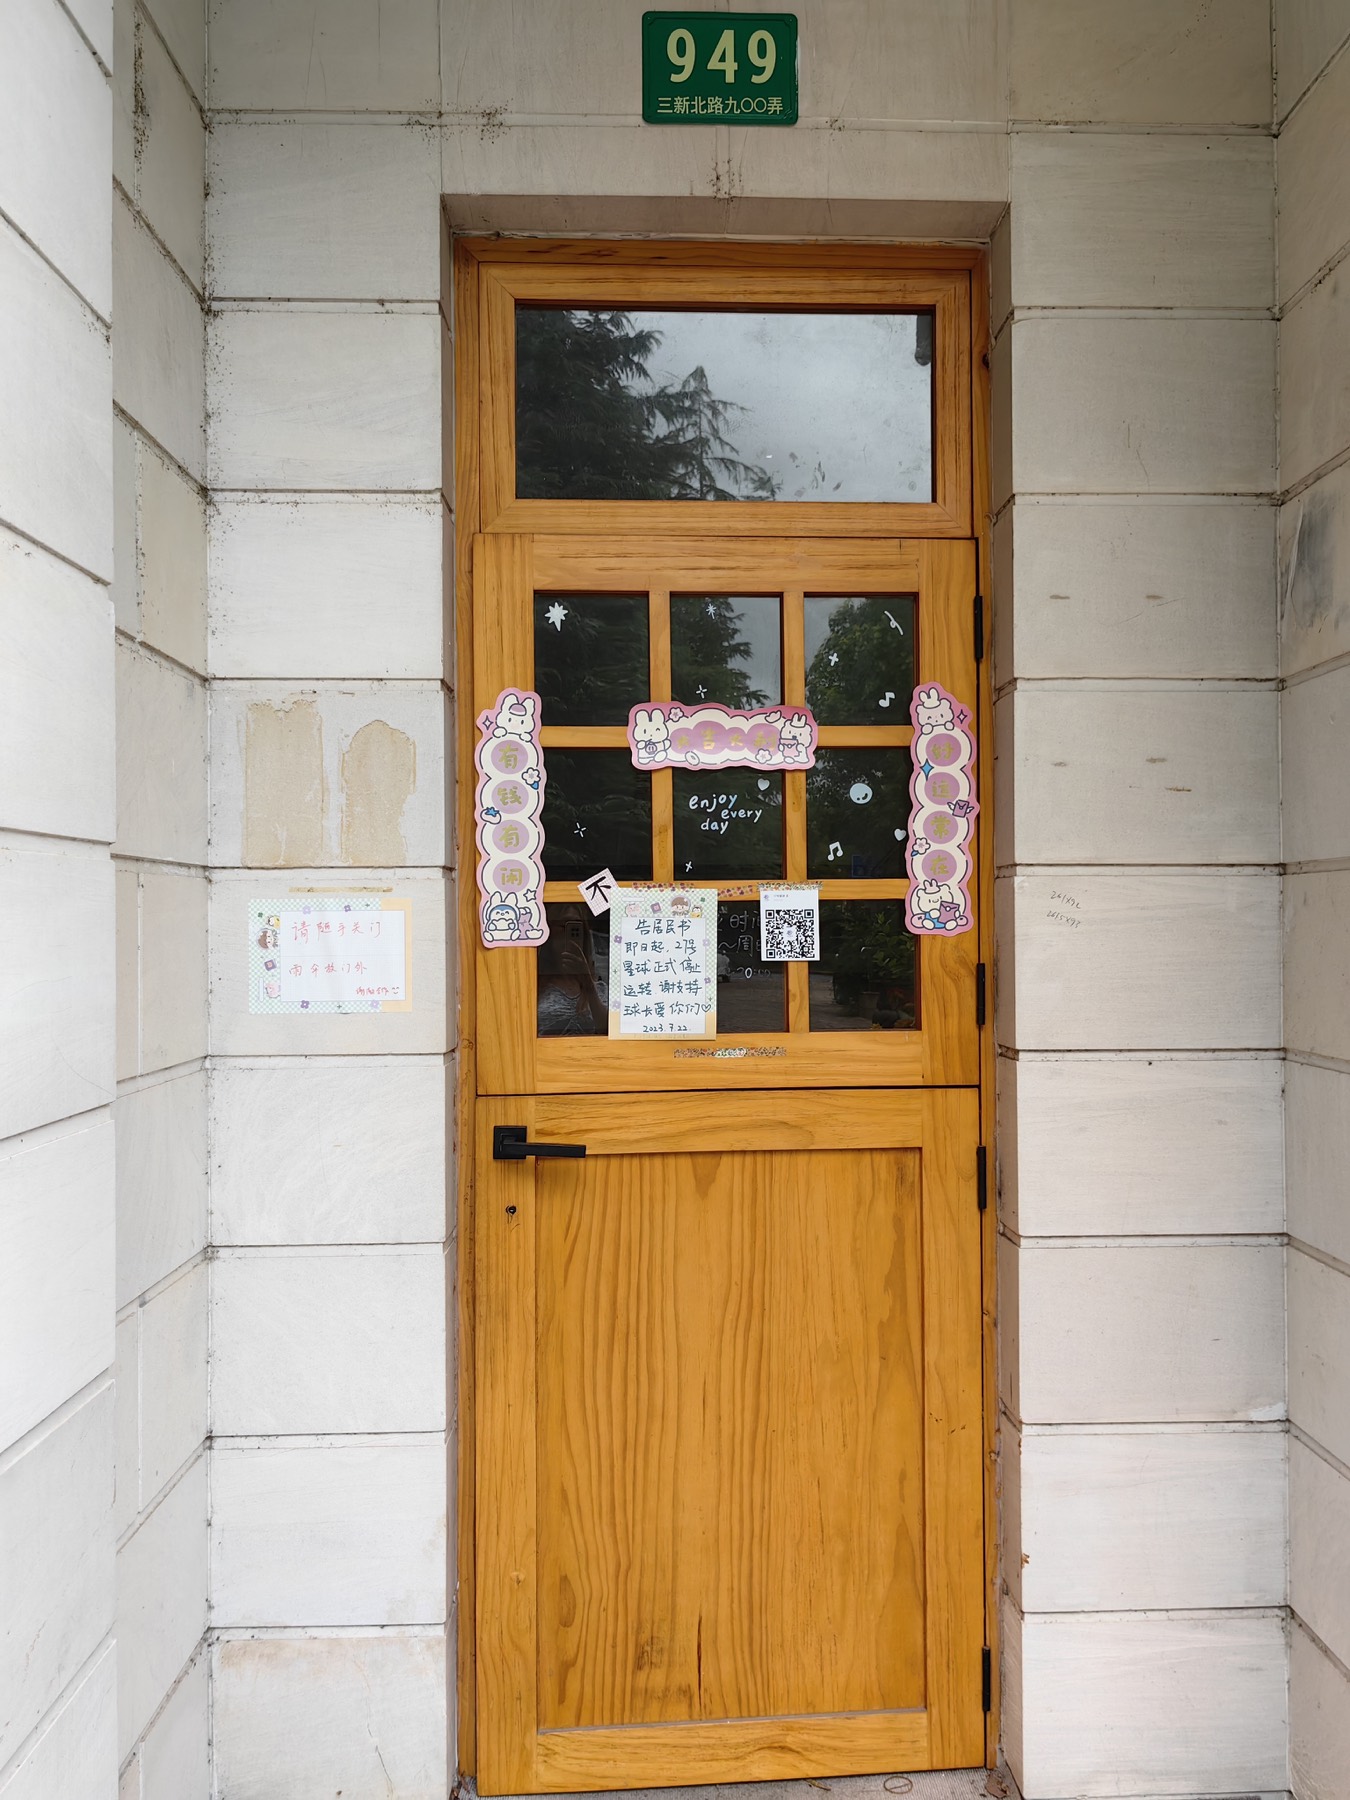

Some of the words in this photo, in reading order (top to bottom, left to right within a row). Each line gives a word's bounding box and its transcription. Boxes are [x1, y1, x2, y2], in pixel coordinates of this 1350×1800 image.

[666, 28, 777, 85] 949
[688, 794, 738, 812] enjoy
[497, 743, 524, 887] 有钱有闲
[721, 808, 763, 823] every
[700, 818, 729, 834] day
[585, 875, 612, 904] 不
[291, 920, 382, 945] 请随手关门
[634, 918, 692, 937] 告居民书
[622, 957, 702, 977] 星球正式停止
[623, 1001, 701, 1018] 球长爱你们
